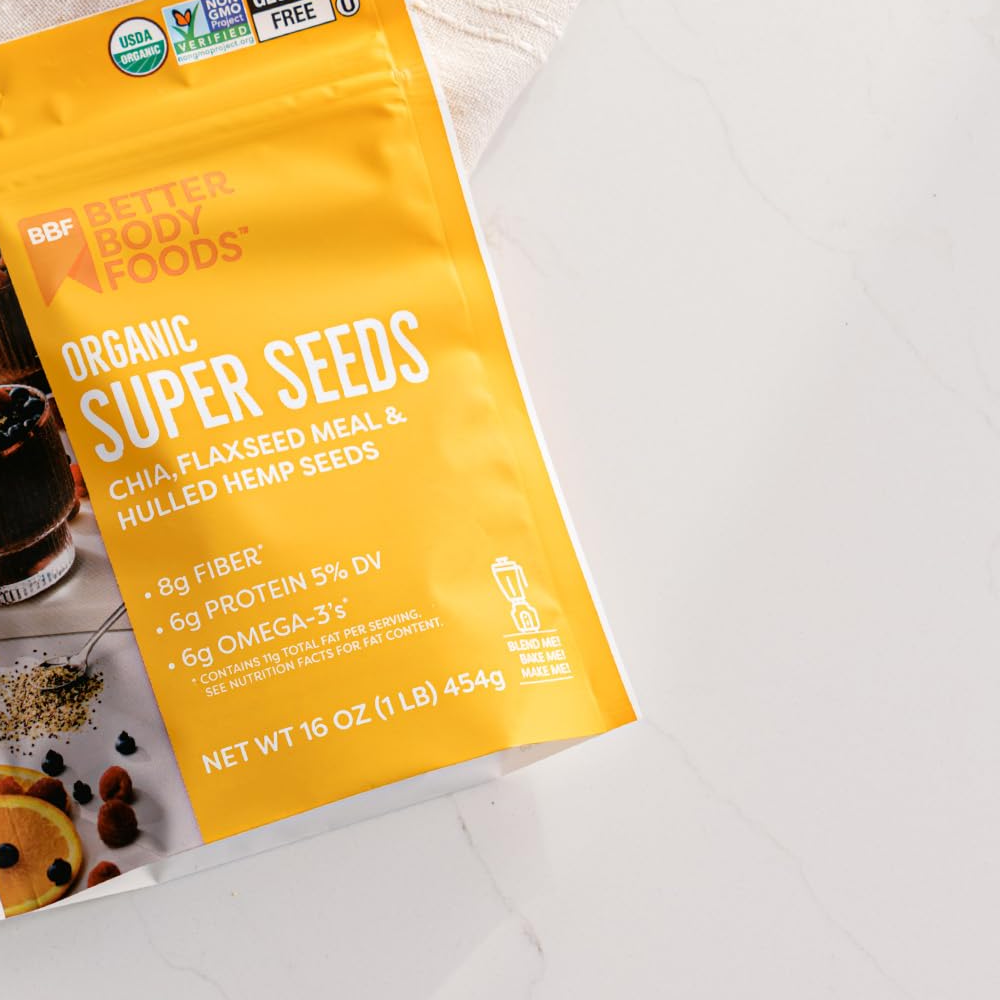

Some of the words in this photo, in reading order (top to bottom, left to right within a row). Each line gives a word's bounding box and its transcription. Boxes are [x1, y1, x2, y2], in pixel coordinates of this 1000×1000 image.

[208, 3, 242, 22] GMO
[211, 14, 245, 30] Project
[271, 2, 317, 30] FREE
[118, 28, 153, 49] USDA
[177, 26, 248, 53] VERIFIED
[177, 35, 255, 63] nongmoproject.org
[120, 43, 161, 66] ORGANIC
[83, 170, 235, 228] BETTER
[27, 217, 74, 246] BBF
[93, 206, 203, 259] BODY
[61, 314, 198, 382] ORGANIC
[79, 353, 264, 463] SUPER
[263, 309, 431, 410] SEEDS
[176, 427, 306, 475] FLAXSEED
[310, 411, 383, 444] MEAL
[384, 405, 408, 426] &
[117, 483, 218, 531] HULLED
[221, 463, 296, 495] HEMP
[299, 440, 381, 478] SEEDS
[157, 575, 191, 597] 8g
[169, 611, 202, 632] 6g
[205, 572, 308, 620] PROTEIN
[311, 561, 349, 587] 5%
[351, 551, 382, 576] DV
[181, 646, 214, 668] 6g
[199, 656, 261, 685] CONTAINS
[262, 652, 281, 665] 11g
[281, 640, 320, 658] TOTAL
[321, 631, 342, 645] FAT
[344, 624, 366, 639] PER
[368, 608, 423, 632] SERVING.
[506, 637, 541, 653] BLEND
[541, 635, 562, 649] ME!
[519, 651, 546, 665] BAKE
[546, 649, 567, 663] ME!
[205, 683, 228, 697] SEE
[230, 661, 296, 690] NUTRITION
[297, 648, 335, 667] FACTS
[336, 641, 362, 656] FOR
[363, 633, 384, 648] FAT
[520, 664, 550, 679] MAKE
[550, 662, 572, 676] ME!
[202, 741, 250, 775] NET
[253, 726, 295, 755] WT
[299, 717, 329, 742] 16
[332, 703, 372, 731] OZ
[374, 695, 396, 721] (1
[397, 680, 438, 713] LB)
[442, 668, 507, 697] 454g
